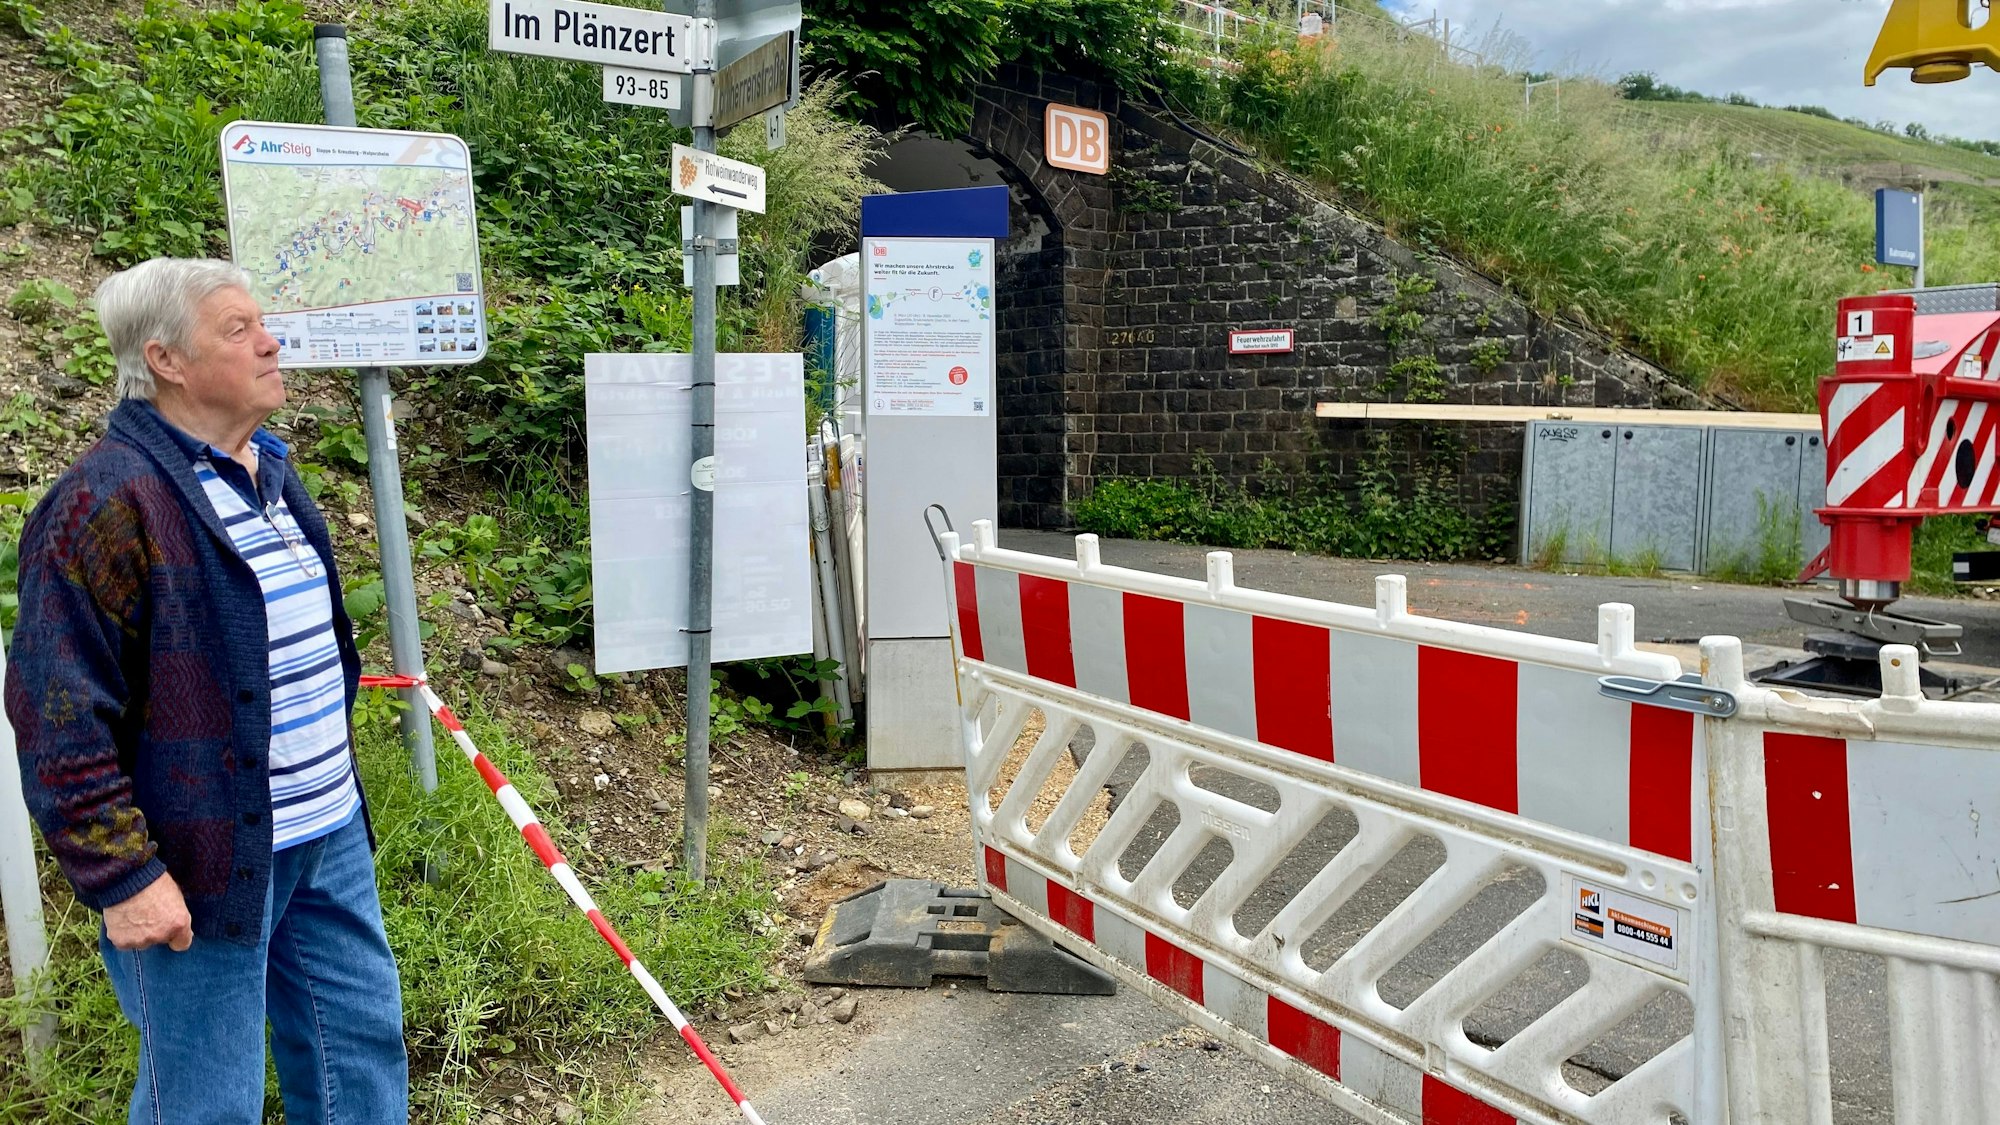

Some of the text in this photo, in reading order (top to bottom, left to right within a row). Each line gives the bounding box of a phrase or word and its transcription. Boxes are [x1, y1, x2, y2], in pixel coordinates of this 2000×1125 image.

[504, 2, 676, 57] Im Plänzert
[615, 75, 669, 100] 93-85
[260, 140, 312, 157] AhrSteig
[1054, 115, 1101, 163] DB
[705, 158, 758, 191] Rotweinwanderweg
[1854, 314, 1862, 332] 1
[1236, 334, 1285, 343] Feuerwehrzufahrt
[1200, 804, 1250, 841] nissen
[1582, 893, 1599, 907] HKL
[1617, 923, 1669, 946] 0800-44 555 44
